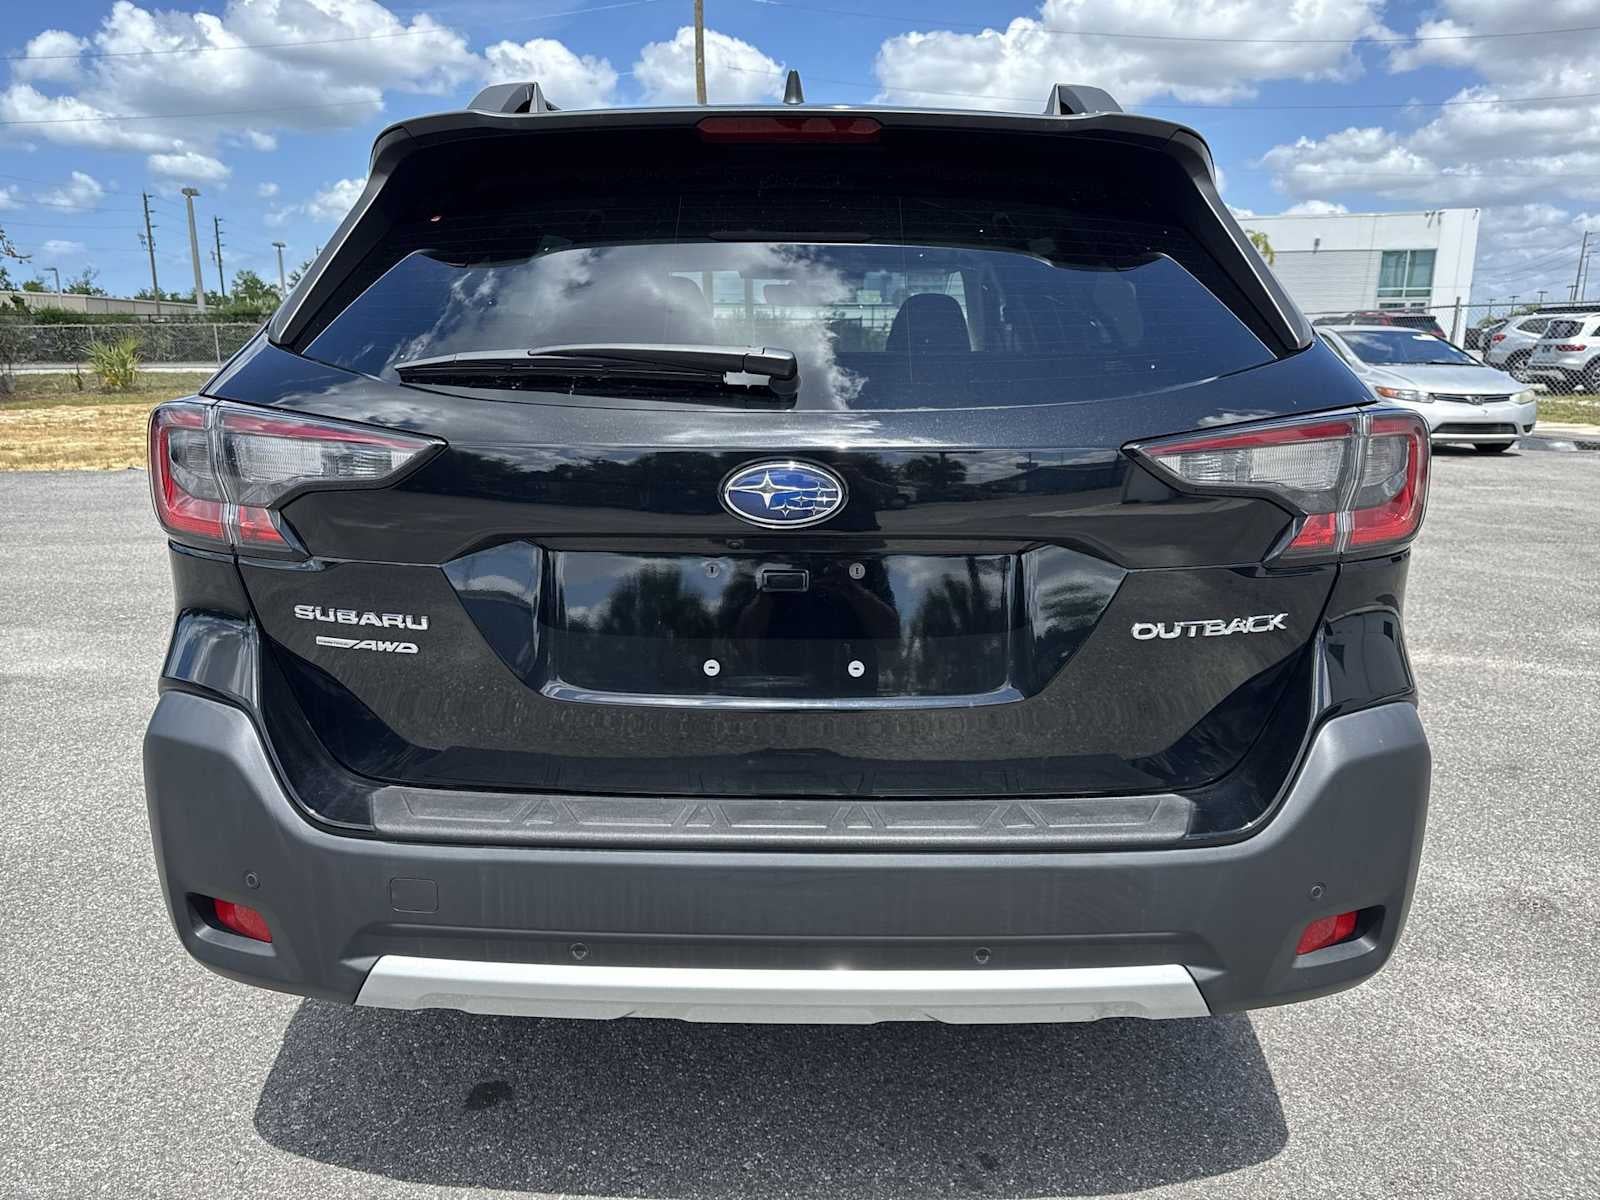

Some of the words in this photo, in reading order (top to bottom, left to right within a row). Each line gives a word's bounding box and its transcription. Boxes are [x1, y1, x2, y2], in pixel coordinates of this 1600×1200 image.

[294, 604, 429, 631] SUBARU
[1131, 613, 1289, 640] OUTBACK
[352, 640, 419, 654] AWD
